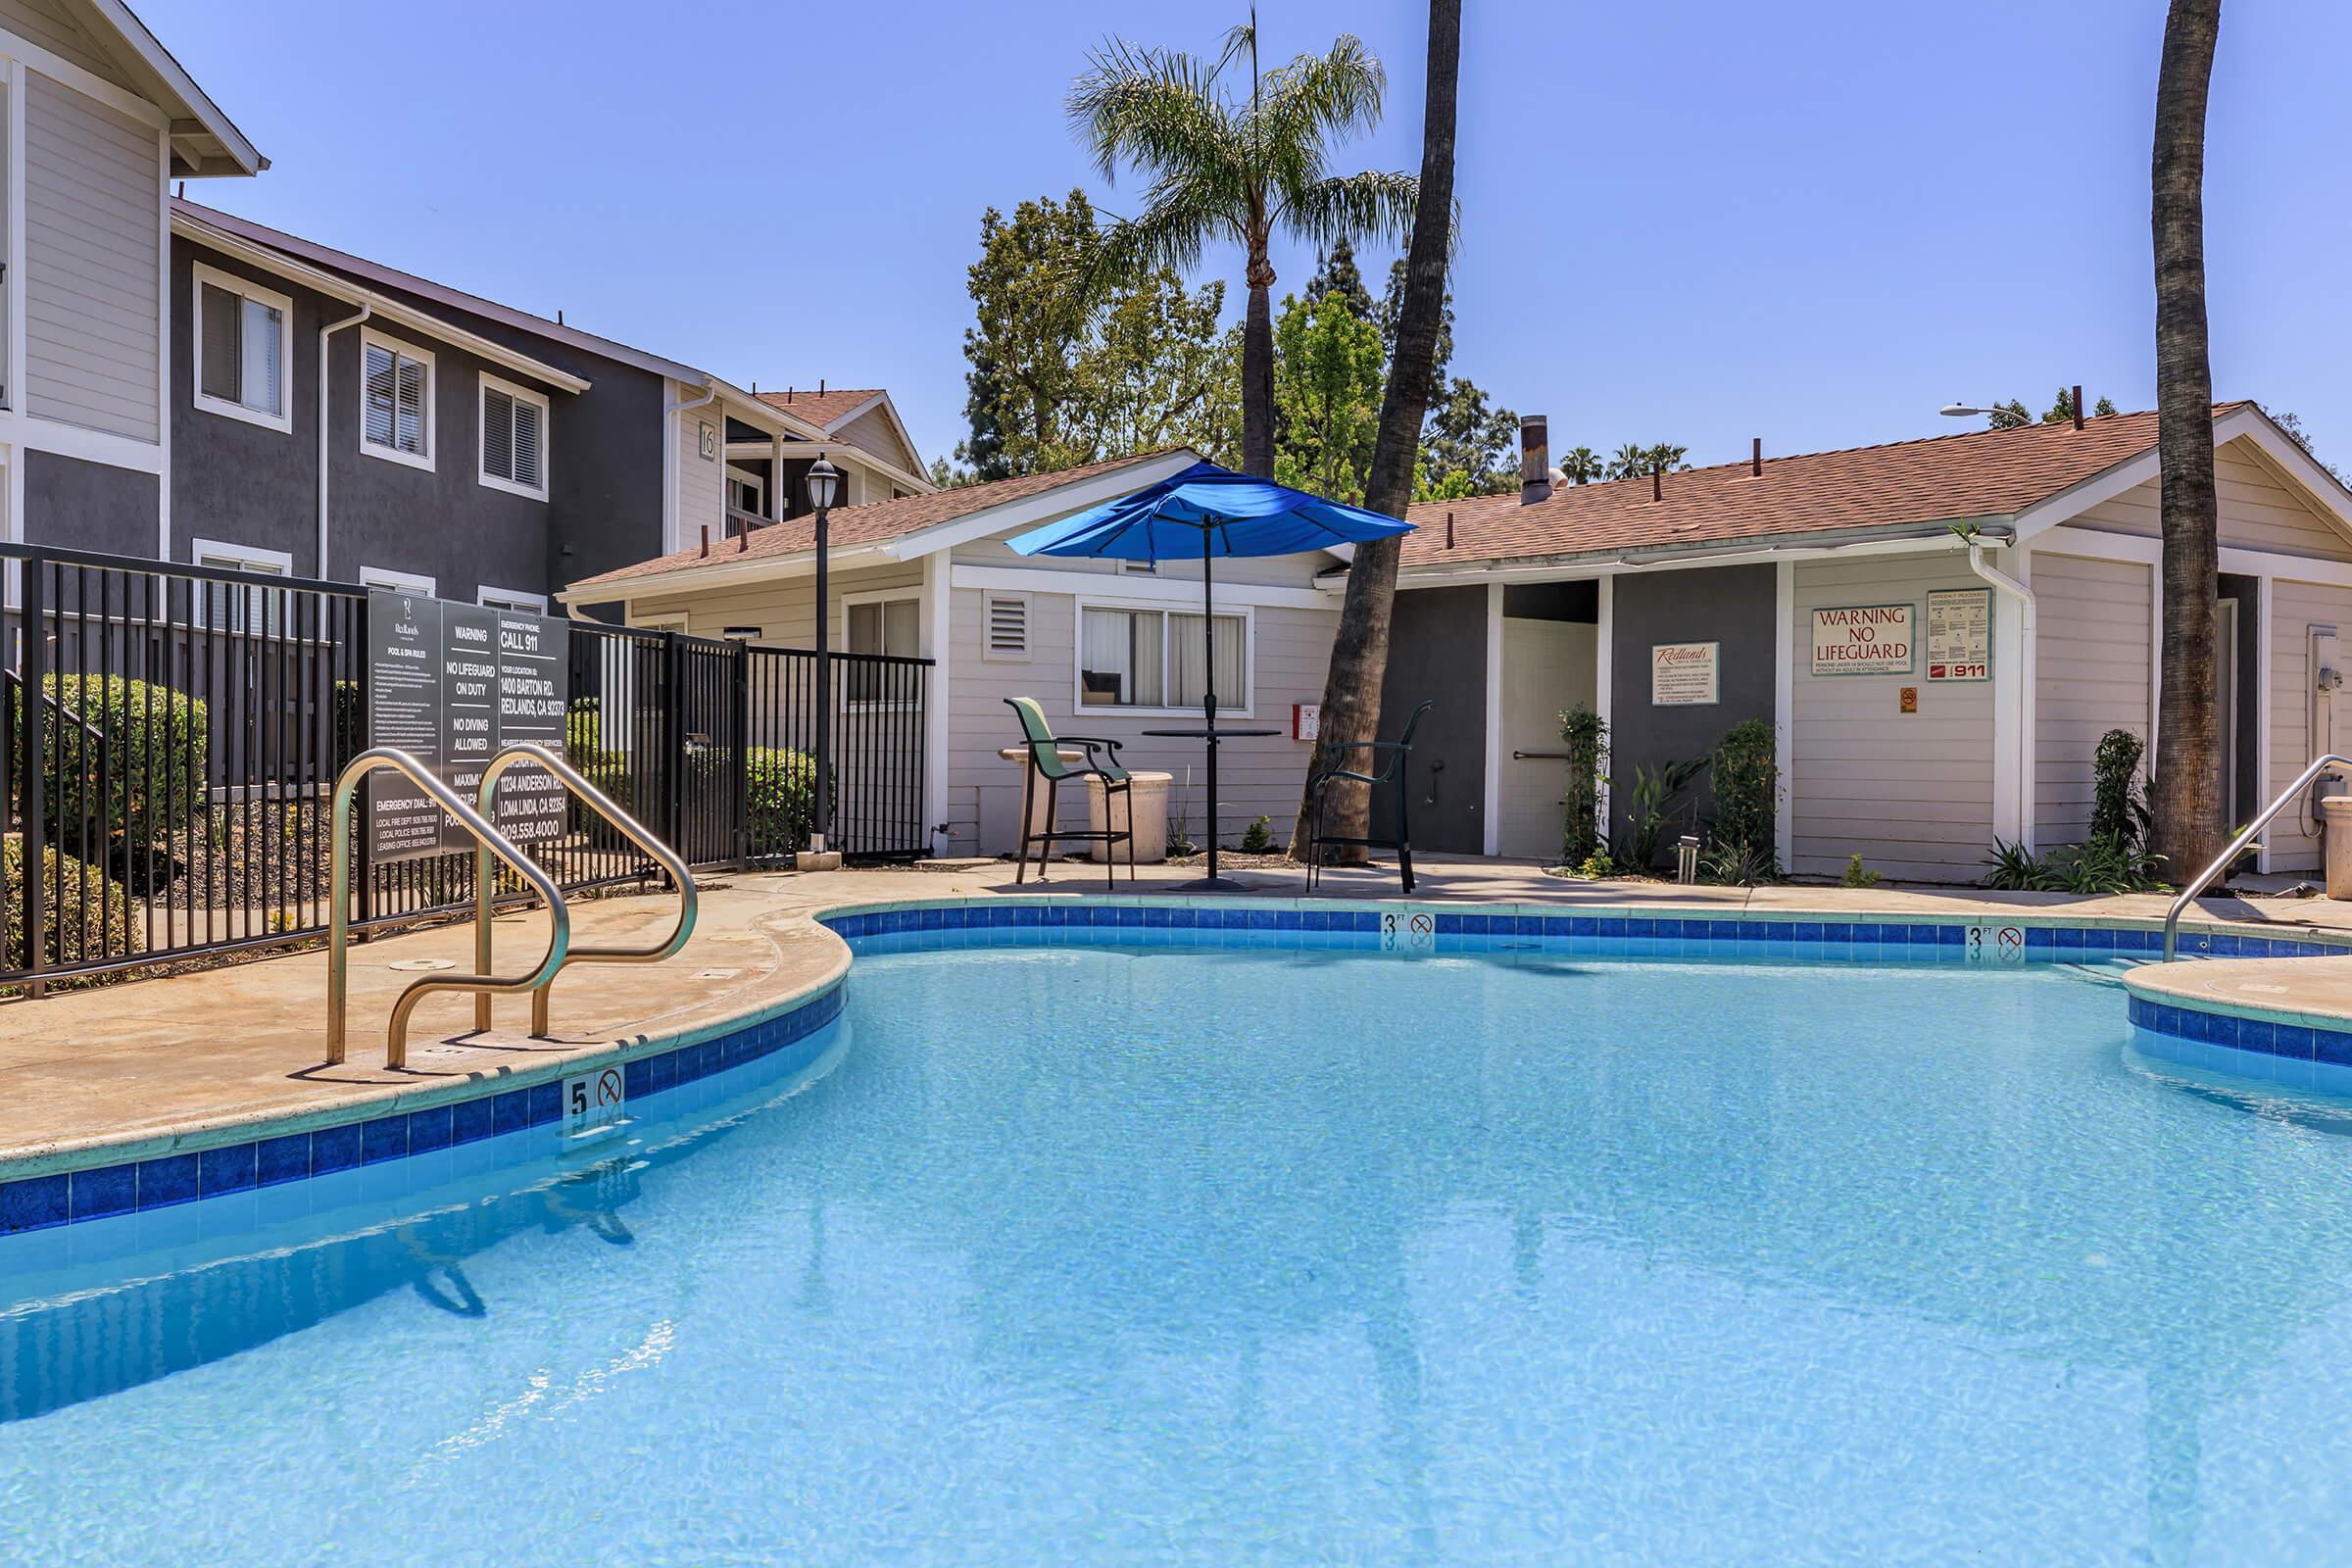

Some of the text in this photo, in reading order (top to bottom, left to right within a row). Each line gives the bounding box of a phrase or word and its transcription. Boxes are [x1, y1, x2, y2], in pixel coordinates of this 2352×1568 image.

[703, 430, 713, 454] 16
[1820, 608, 1904, 626] WARNING
[455, 626, 488, 642] WARNING
[501, 631, 538, 652] CALL 911
[1849, 627, 1875, 643] NO
[387, 647, 401, 657] POOL
[404, 649, 413, 658] SPA
[413, 650, 426, 659] RULES
[1657, 647, 1707, 665] Redlands
[1817, 644, 1907, 661] LIFEGUARD
[446, 662, 496, 677] NO LIFEGUARD
[501, 665, 513, 674] YOUR
[513, 666, 533, 675] LOCATION
[1954, 664, 1984, 677] 911
[456, 682, 487, 697] ON DUTY
[501, 677, 555, 697] 1400 BARTON RD.
[501, 698, 564, 717] REDLANDS, CA 92373
[454, 718, 489, 732] NO DIVING
[455, 738, 488, 751] ALLOWED
[501, 776, 516, 793] 11234
[517, 774, 552, 792] ANDERSON
[376, 799, 414, 811] EMERGENCY
[414, 798, 428, 808] DIAL:
[501, 800, 518, 817] LOMA
[518, 799, 539, 816] LINDA,
[539, 798, 548, 813] CA
[549, 797, 565, 812] 92354
[376, 817, 391, 828] LOCAL
[391, 817, 401, 826] FIRE
[501, 820, 559, 840] 909.558.4000
[379, 830, 395, 840] LOCAL
[376, 841, 396, 852] LEASING
[1385, 914, 1396, 934] 3
[1970, 927, 1982, 946] 3
[572, 1081, 587, 1115] 5
